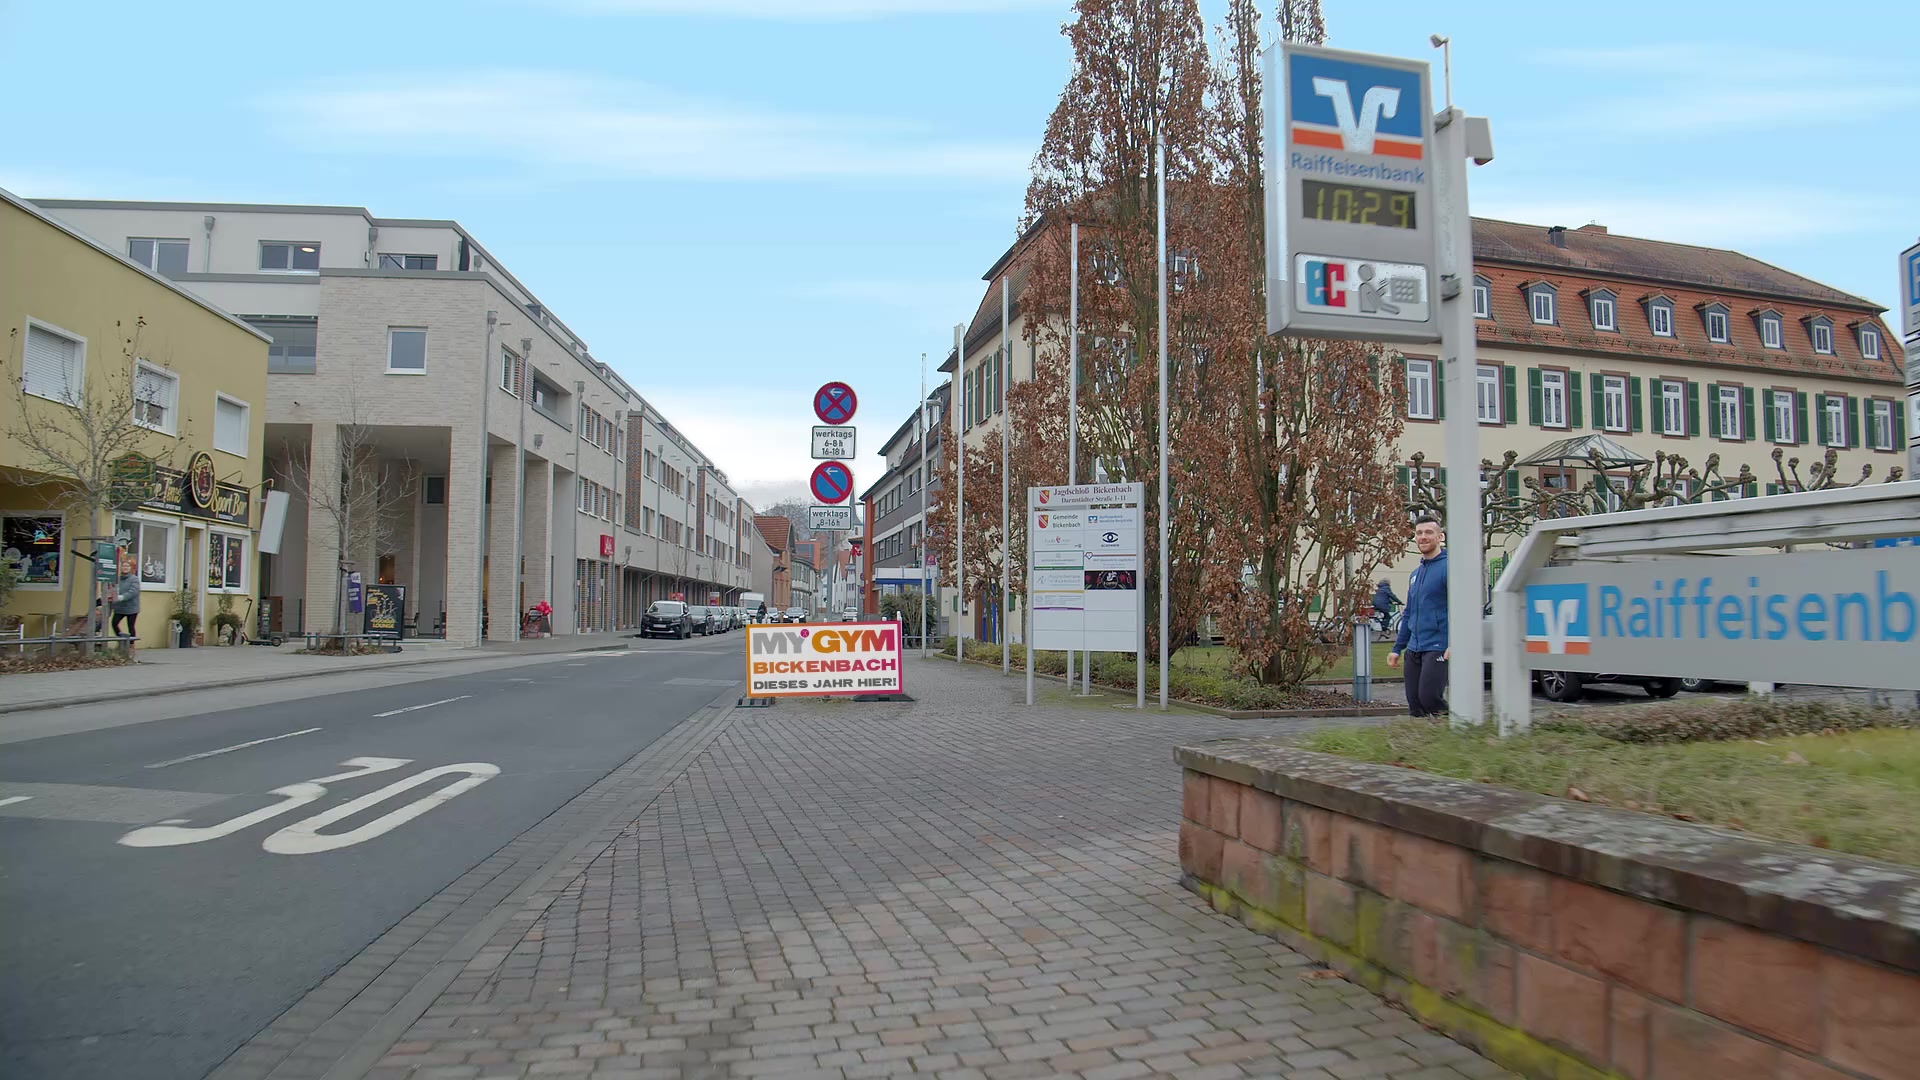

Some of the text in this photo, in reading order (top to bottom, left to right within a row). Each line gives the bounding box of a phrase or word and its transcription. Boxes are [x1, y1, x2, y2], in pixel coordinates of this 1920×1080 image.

[1291, 152, 1425, 184] Raiffeisenbank
[1316, 188, 1409, 228] 10:29
[815, 430, 853, 439] werktags
[1053, 485, 1132, 496] Jagdschloß Bickenbach
[812, 510, 849, 519] werktags
[1600, 570, 1918, 642] Raiffeisenb
[752, 630, 896, 655] MY GYM
[753, 658, 896, 674] BICKENBACH
[754, 678, 897, 690] DIESES JAHR HIER!
